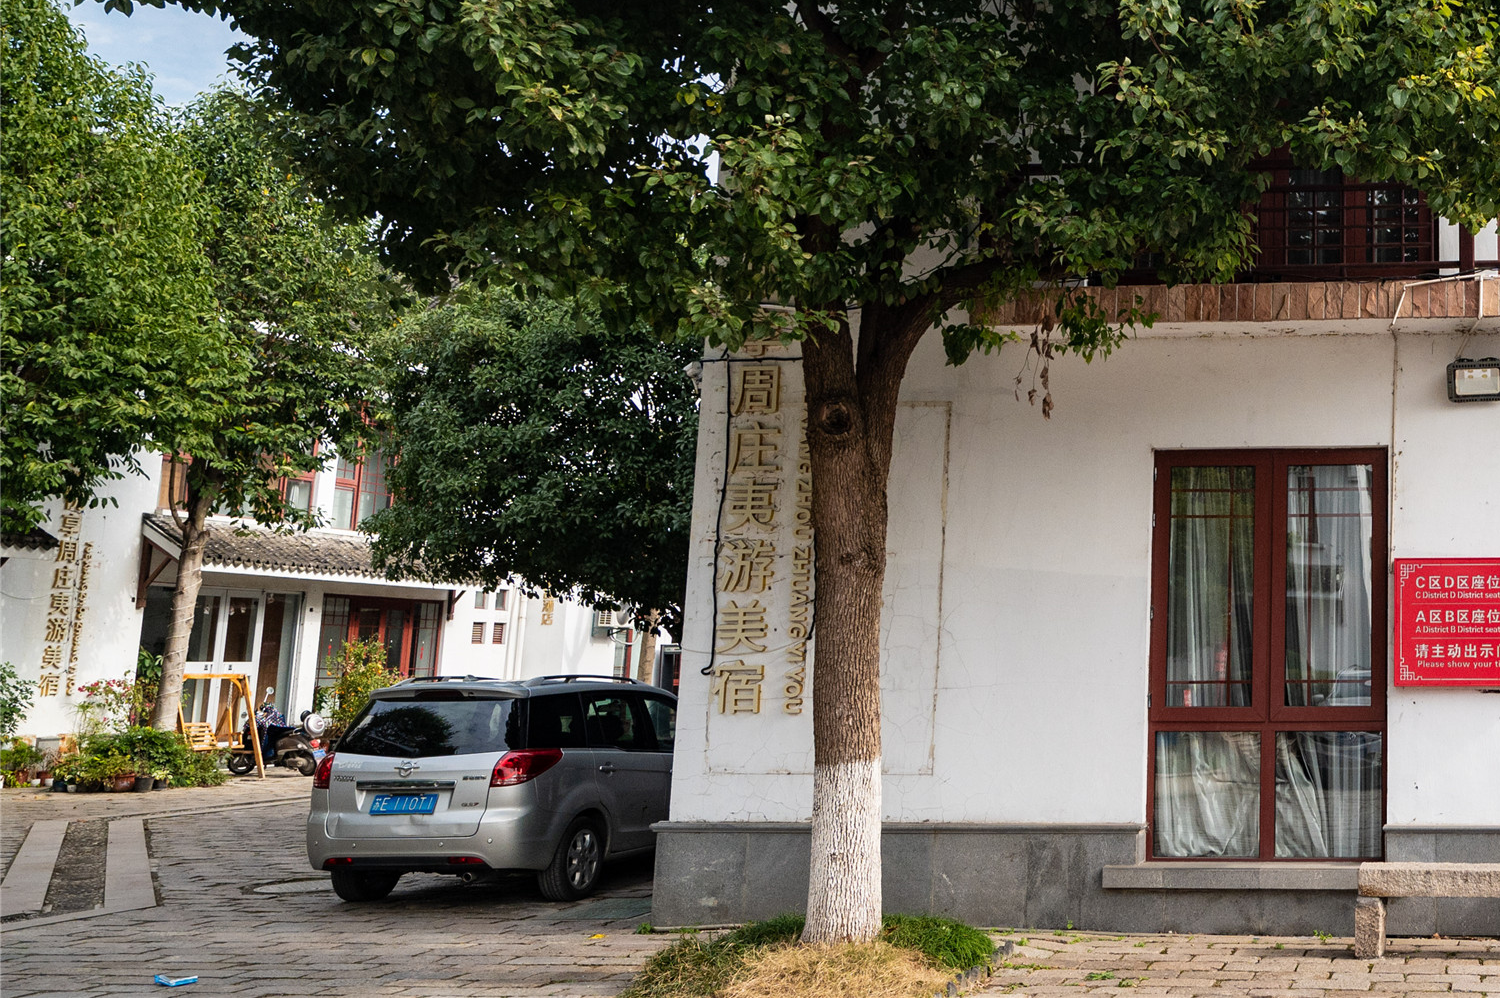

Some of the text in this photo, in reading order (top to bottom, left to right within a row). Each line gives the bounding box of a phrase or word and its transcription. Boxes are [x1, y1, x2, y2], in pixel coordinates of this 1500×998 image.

[1416, 575, 1500, 589] C区D区座位
[1416, 609, 1500, 623] A区B区座位
